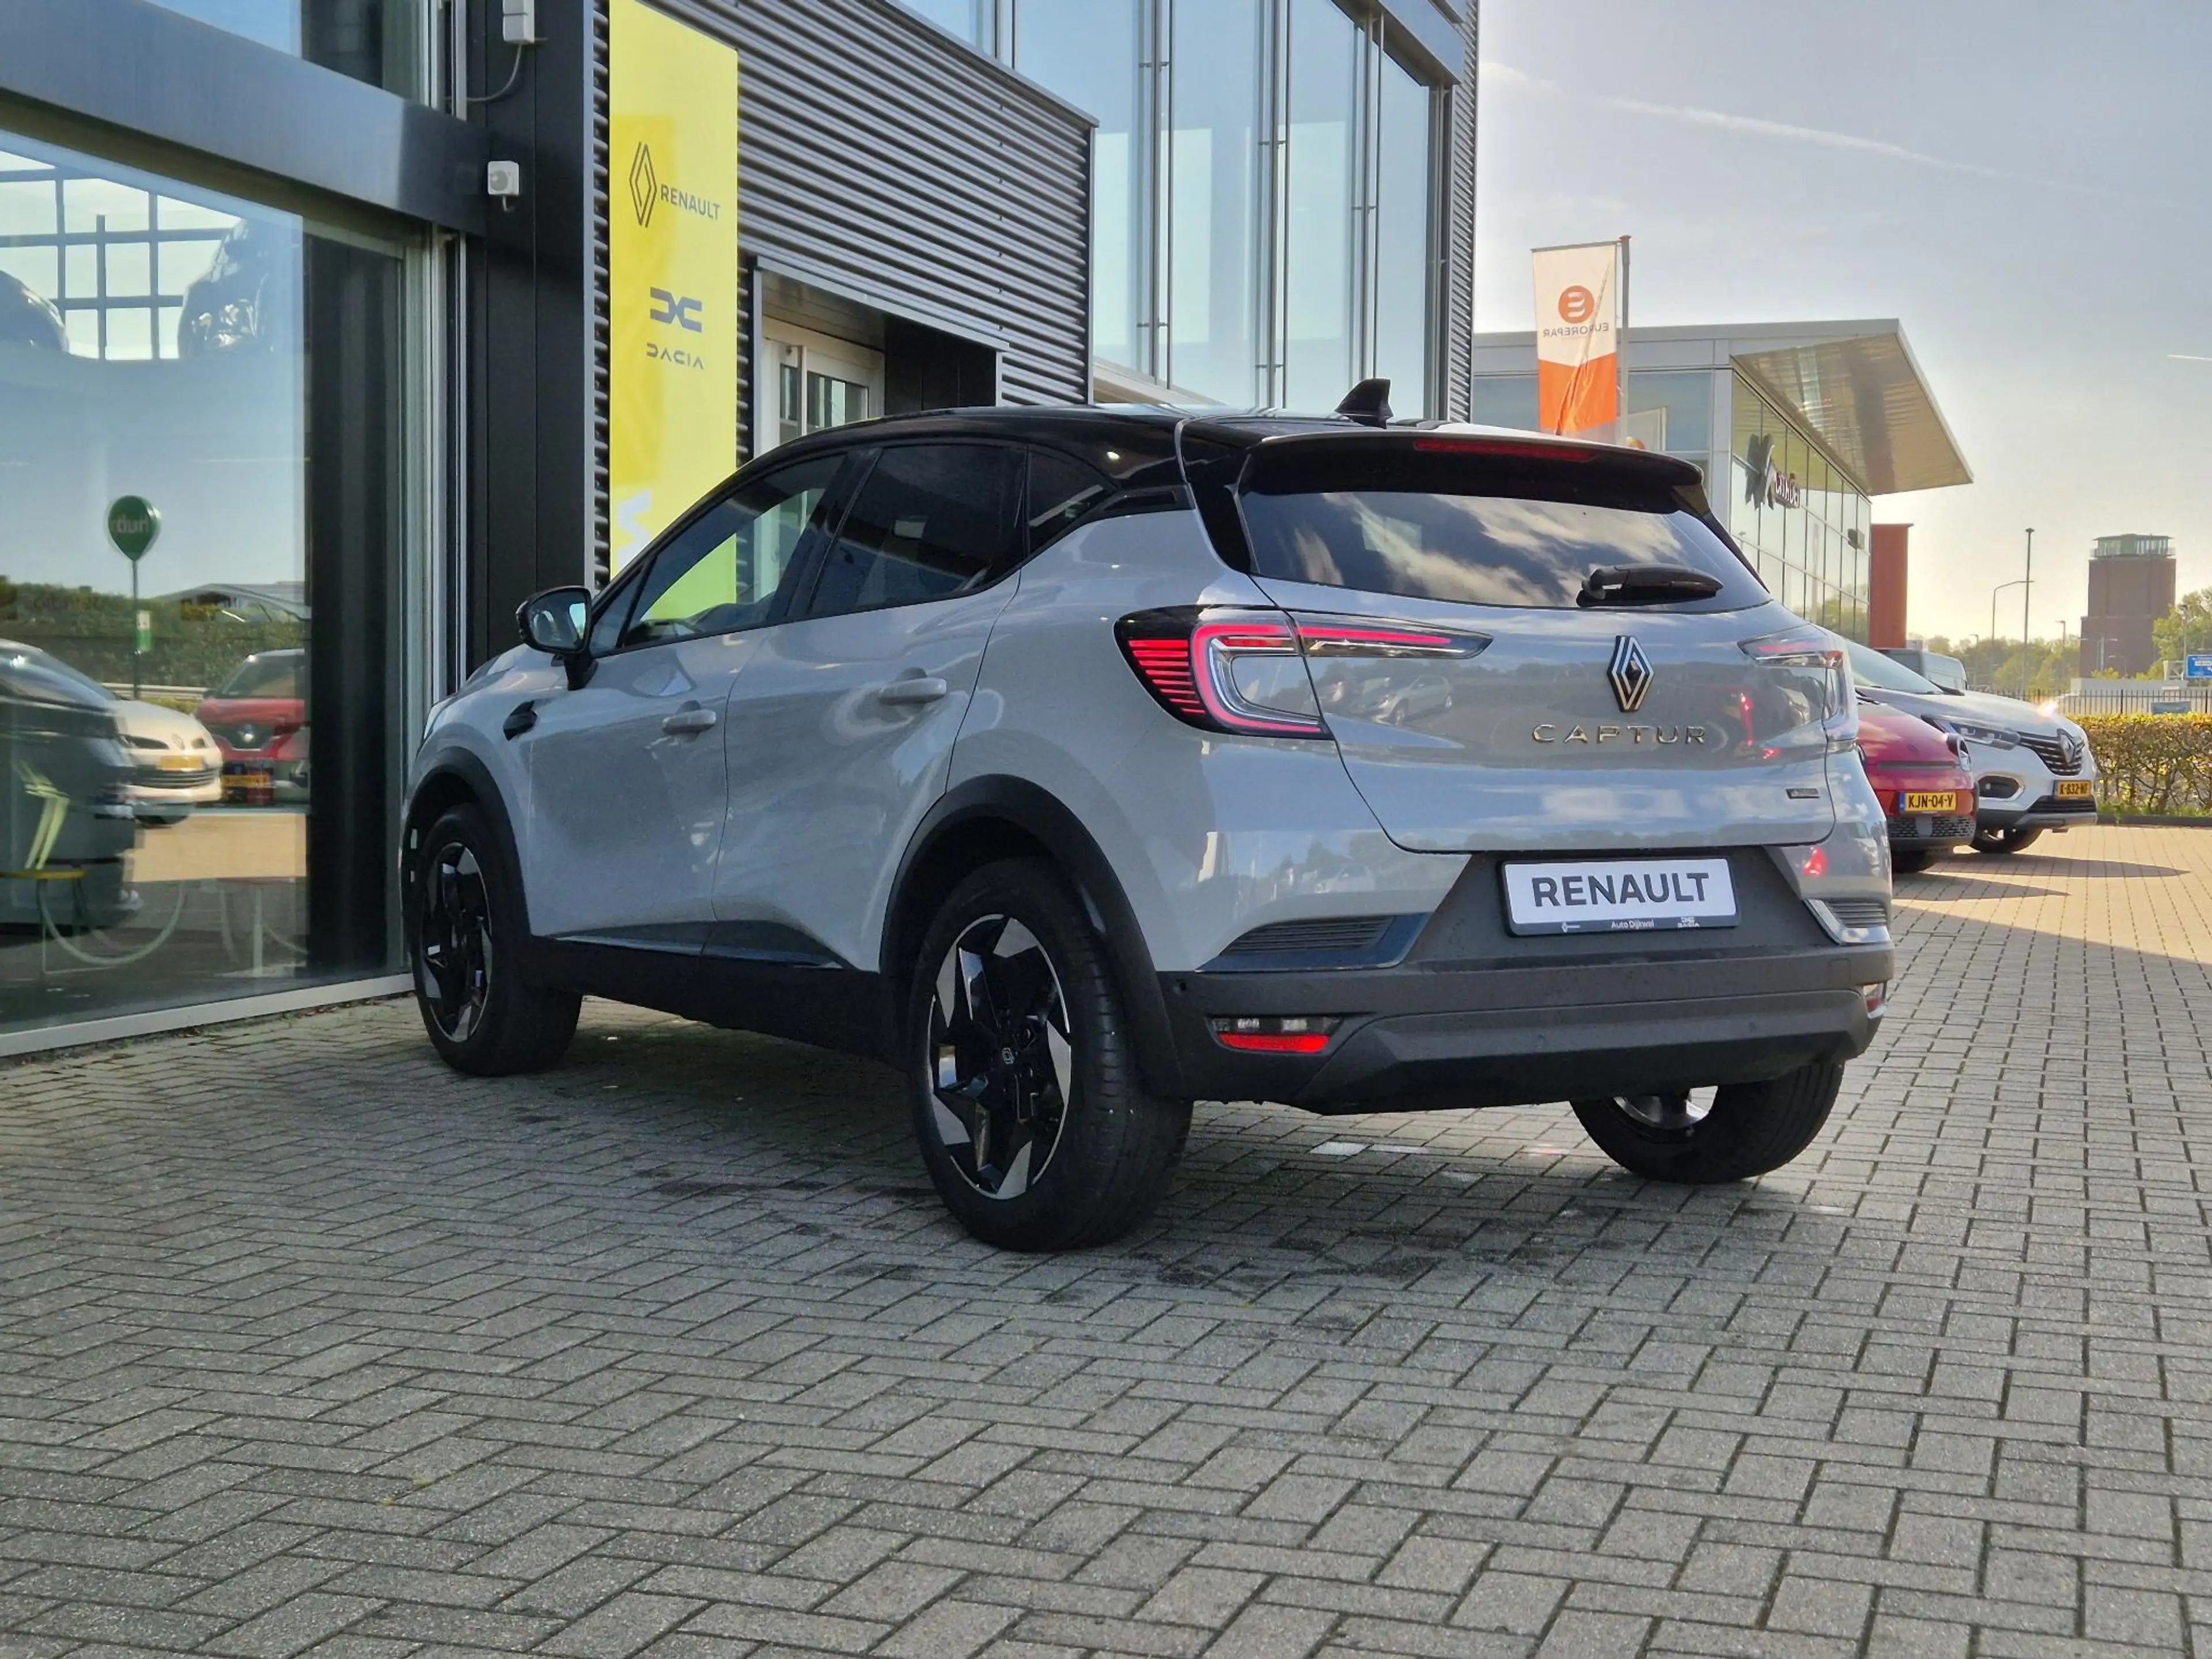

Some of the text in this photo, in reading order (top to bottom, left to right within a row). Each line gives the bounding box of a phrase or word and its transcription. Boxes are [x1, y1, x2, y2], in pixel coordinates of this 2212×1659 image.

[660, 184, 721, 221] RENAULT
[646, 342, 704, 370] DACIA
[1531, 724, 1707, 744] CAPTUR
[1531, 872, 1709, 908] RENAULT
[1611, 921, 1628, 929] Auto
